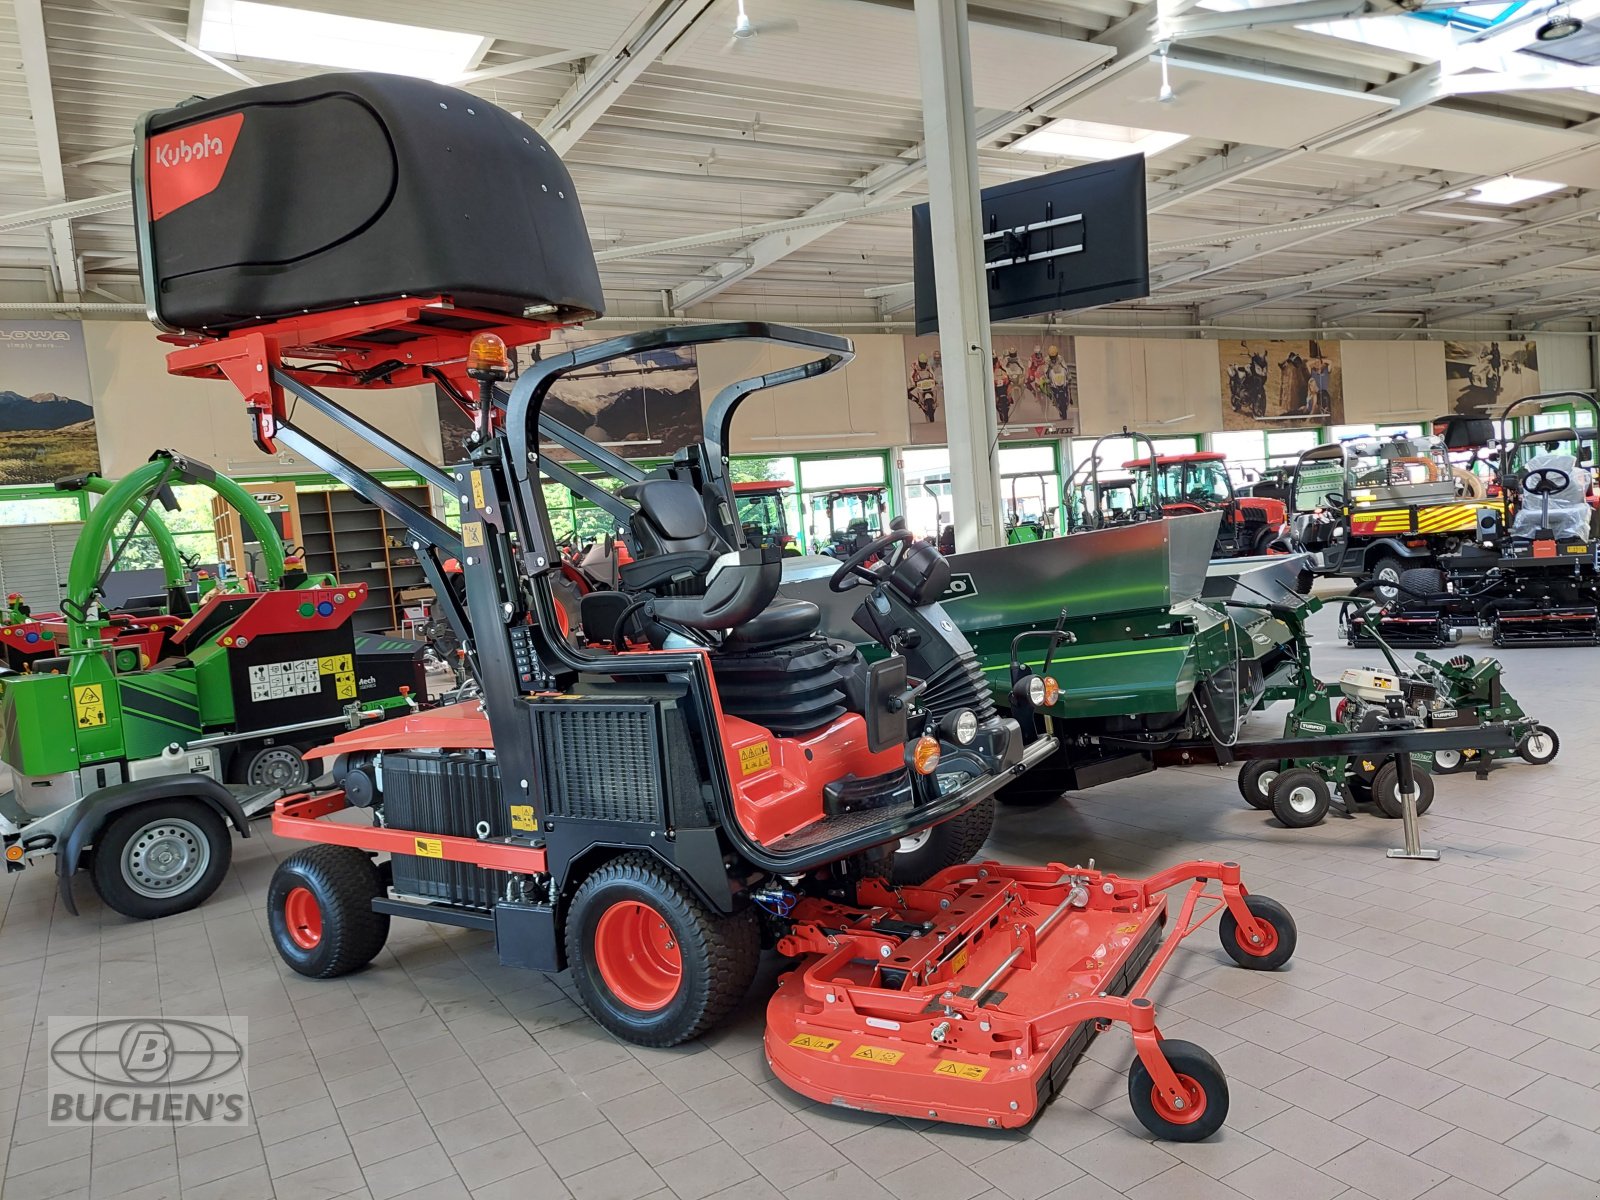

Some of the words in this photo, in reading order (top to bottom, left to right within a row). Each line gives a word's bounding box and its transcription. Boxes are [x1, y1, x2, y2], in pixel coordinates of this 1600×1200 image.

[156, 133, 223, 168] Kubota
[0, 331, 70, 341] LOWA
[1302, 723, 1324, 731] TURFCO
